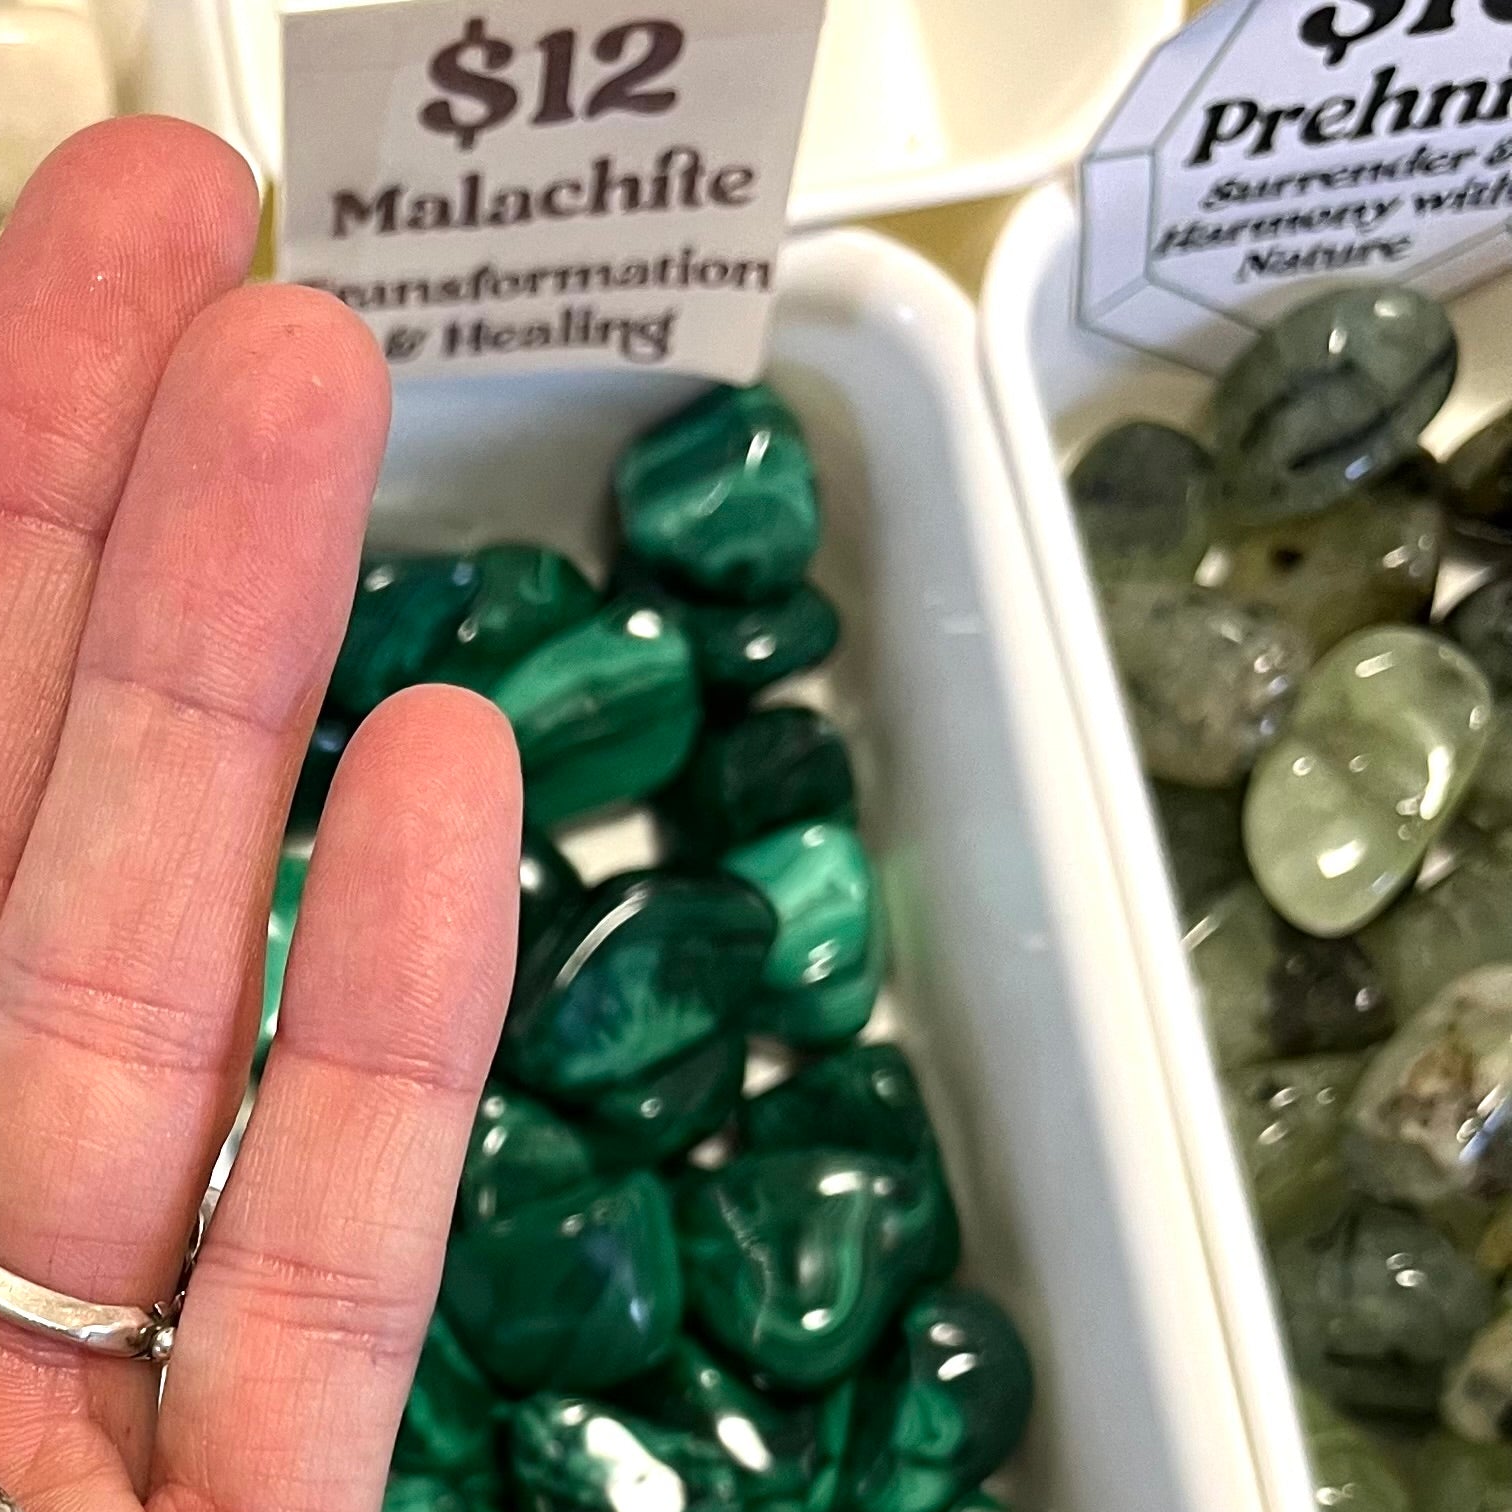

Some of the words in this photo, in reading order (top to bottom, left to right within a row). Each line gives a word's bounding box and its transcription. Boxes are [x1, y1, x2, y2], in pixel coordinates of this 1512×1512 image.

[419, 18, 685, 151] $12
[329, 148, 755, 238] Malachite
[1198, 145, 1477, 211] Surrender
[1153, 194, 1402, 256] Harmony
[294, 248, 772, 311] ransformation
[1233, 234, 1411, 283] Nature
[384, 324, 428, 362] &
[442, 306, 678, 363] Healing
